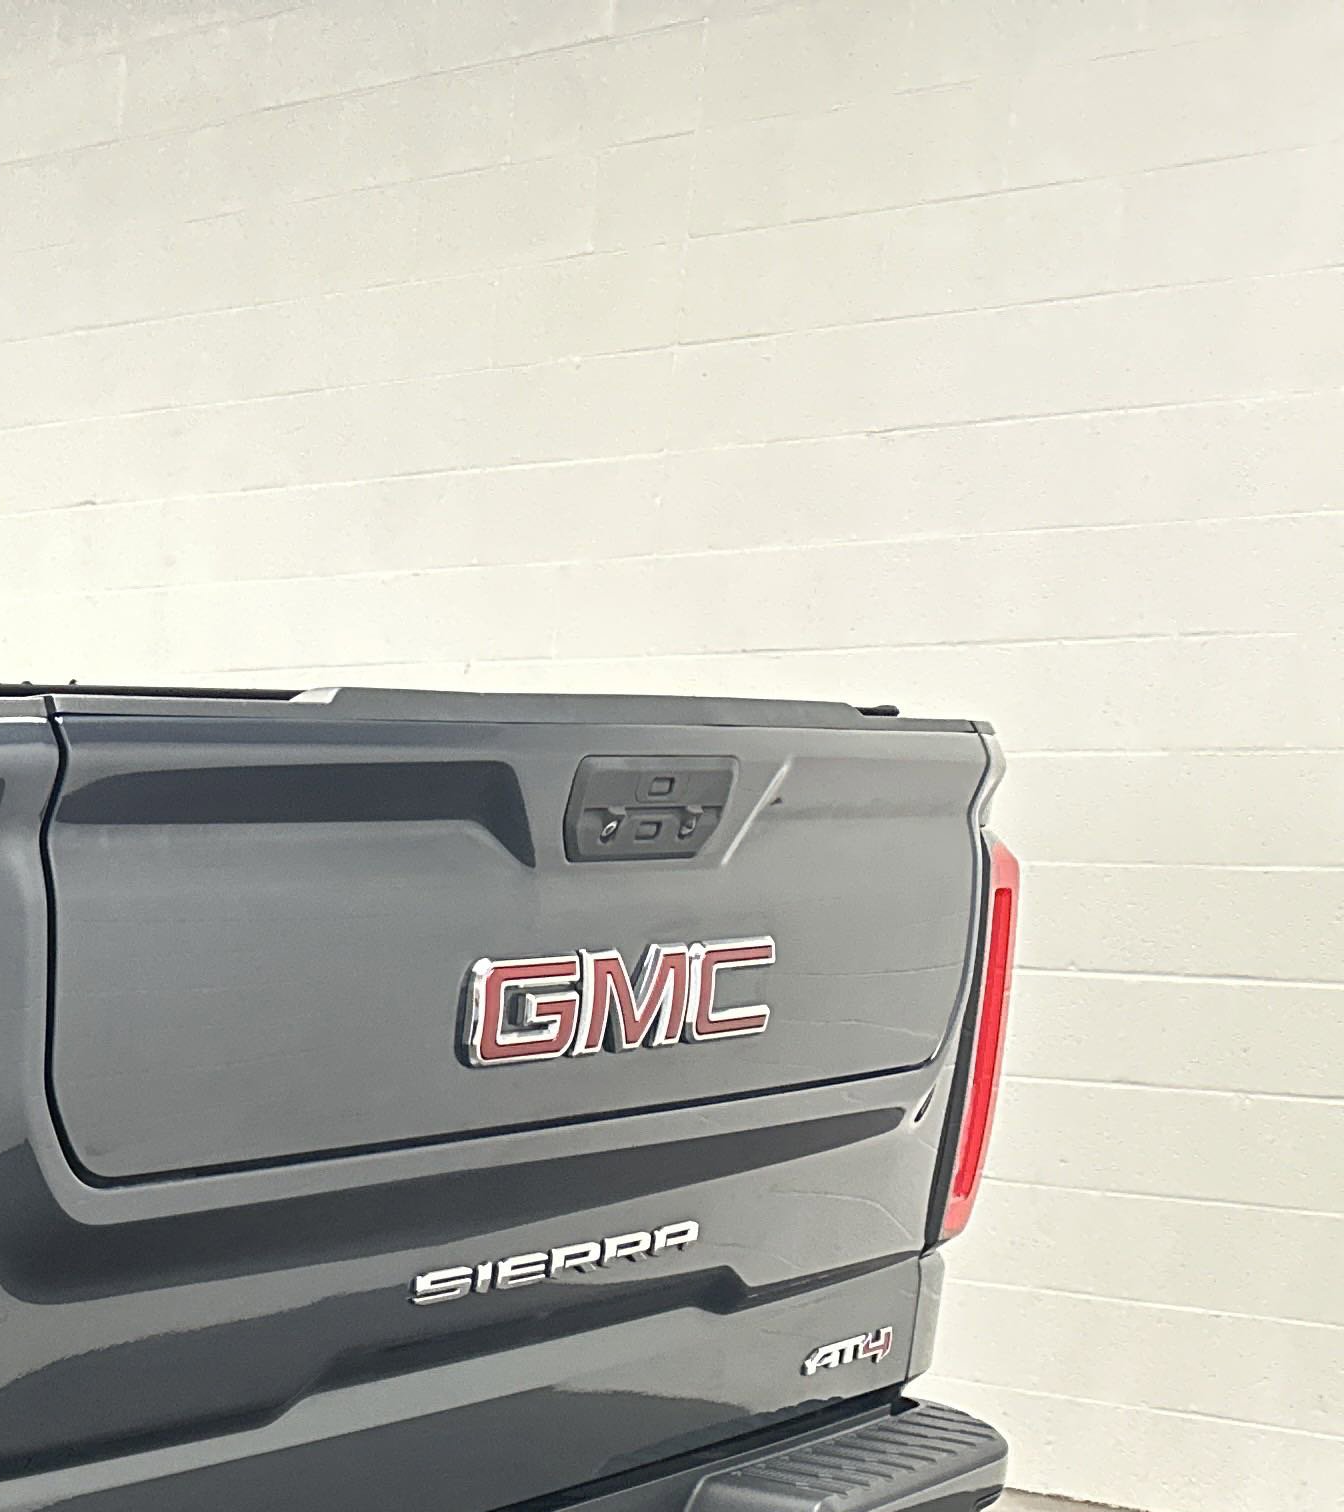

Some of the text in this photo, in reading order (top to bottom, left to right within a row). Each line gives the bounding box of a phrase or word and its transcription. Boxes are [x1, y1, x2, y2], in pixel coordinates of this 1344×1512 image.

[457, 935, 776, 1067] GMC
[408, 1220, 700, 1306] SIERRA
[800, 1326, 893, 1376] AT4
